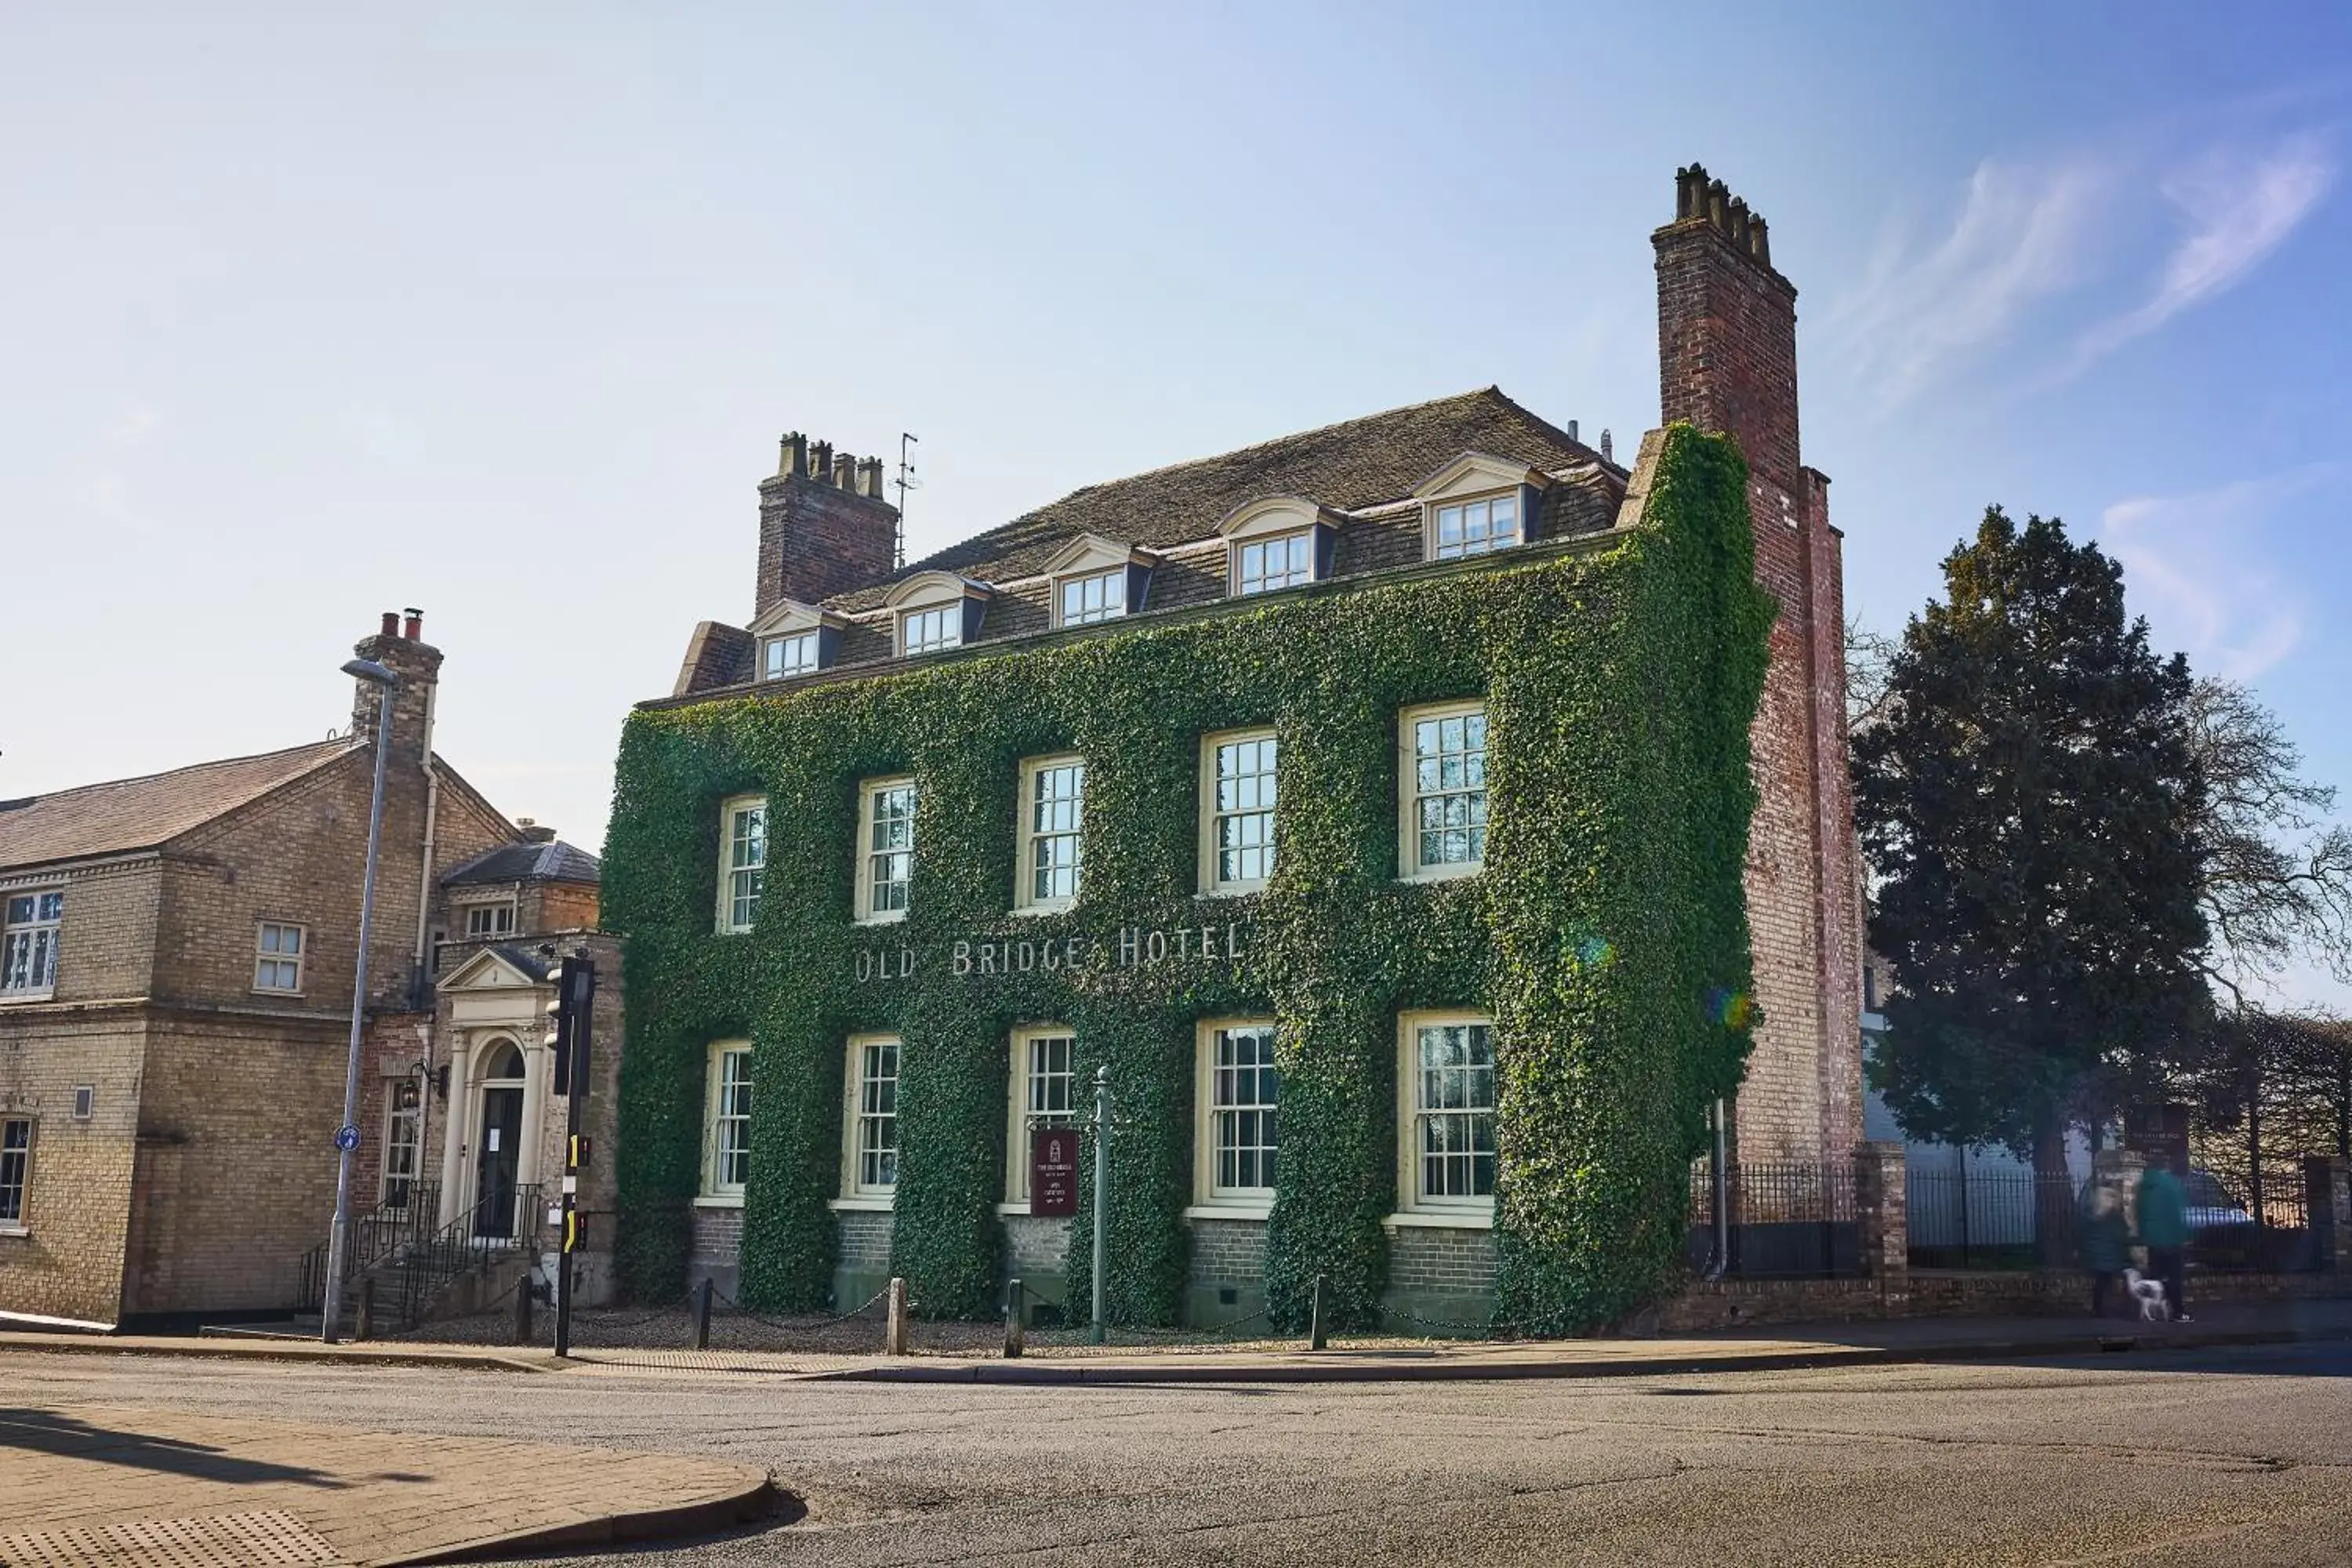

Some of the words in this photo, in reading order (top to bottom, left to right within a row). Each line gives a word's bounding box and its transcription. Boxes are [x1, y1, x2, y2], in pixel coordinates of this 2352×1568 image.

[855, 947, 915, 983] OLD
[953, 937, 1083, 975] BRIDGE
[1120, 923, 1244, 966] HOTEL
